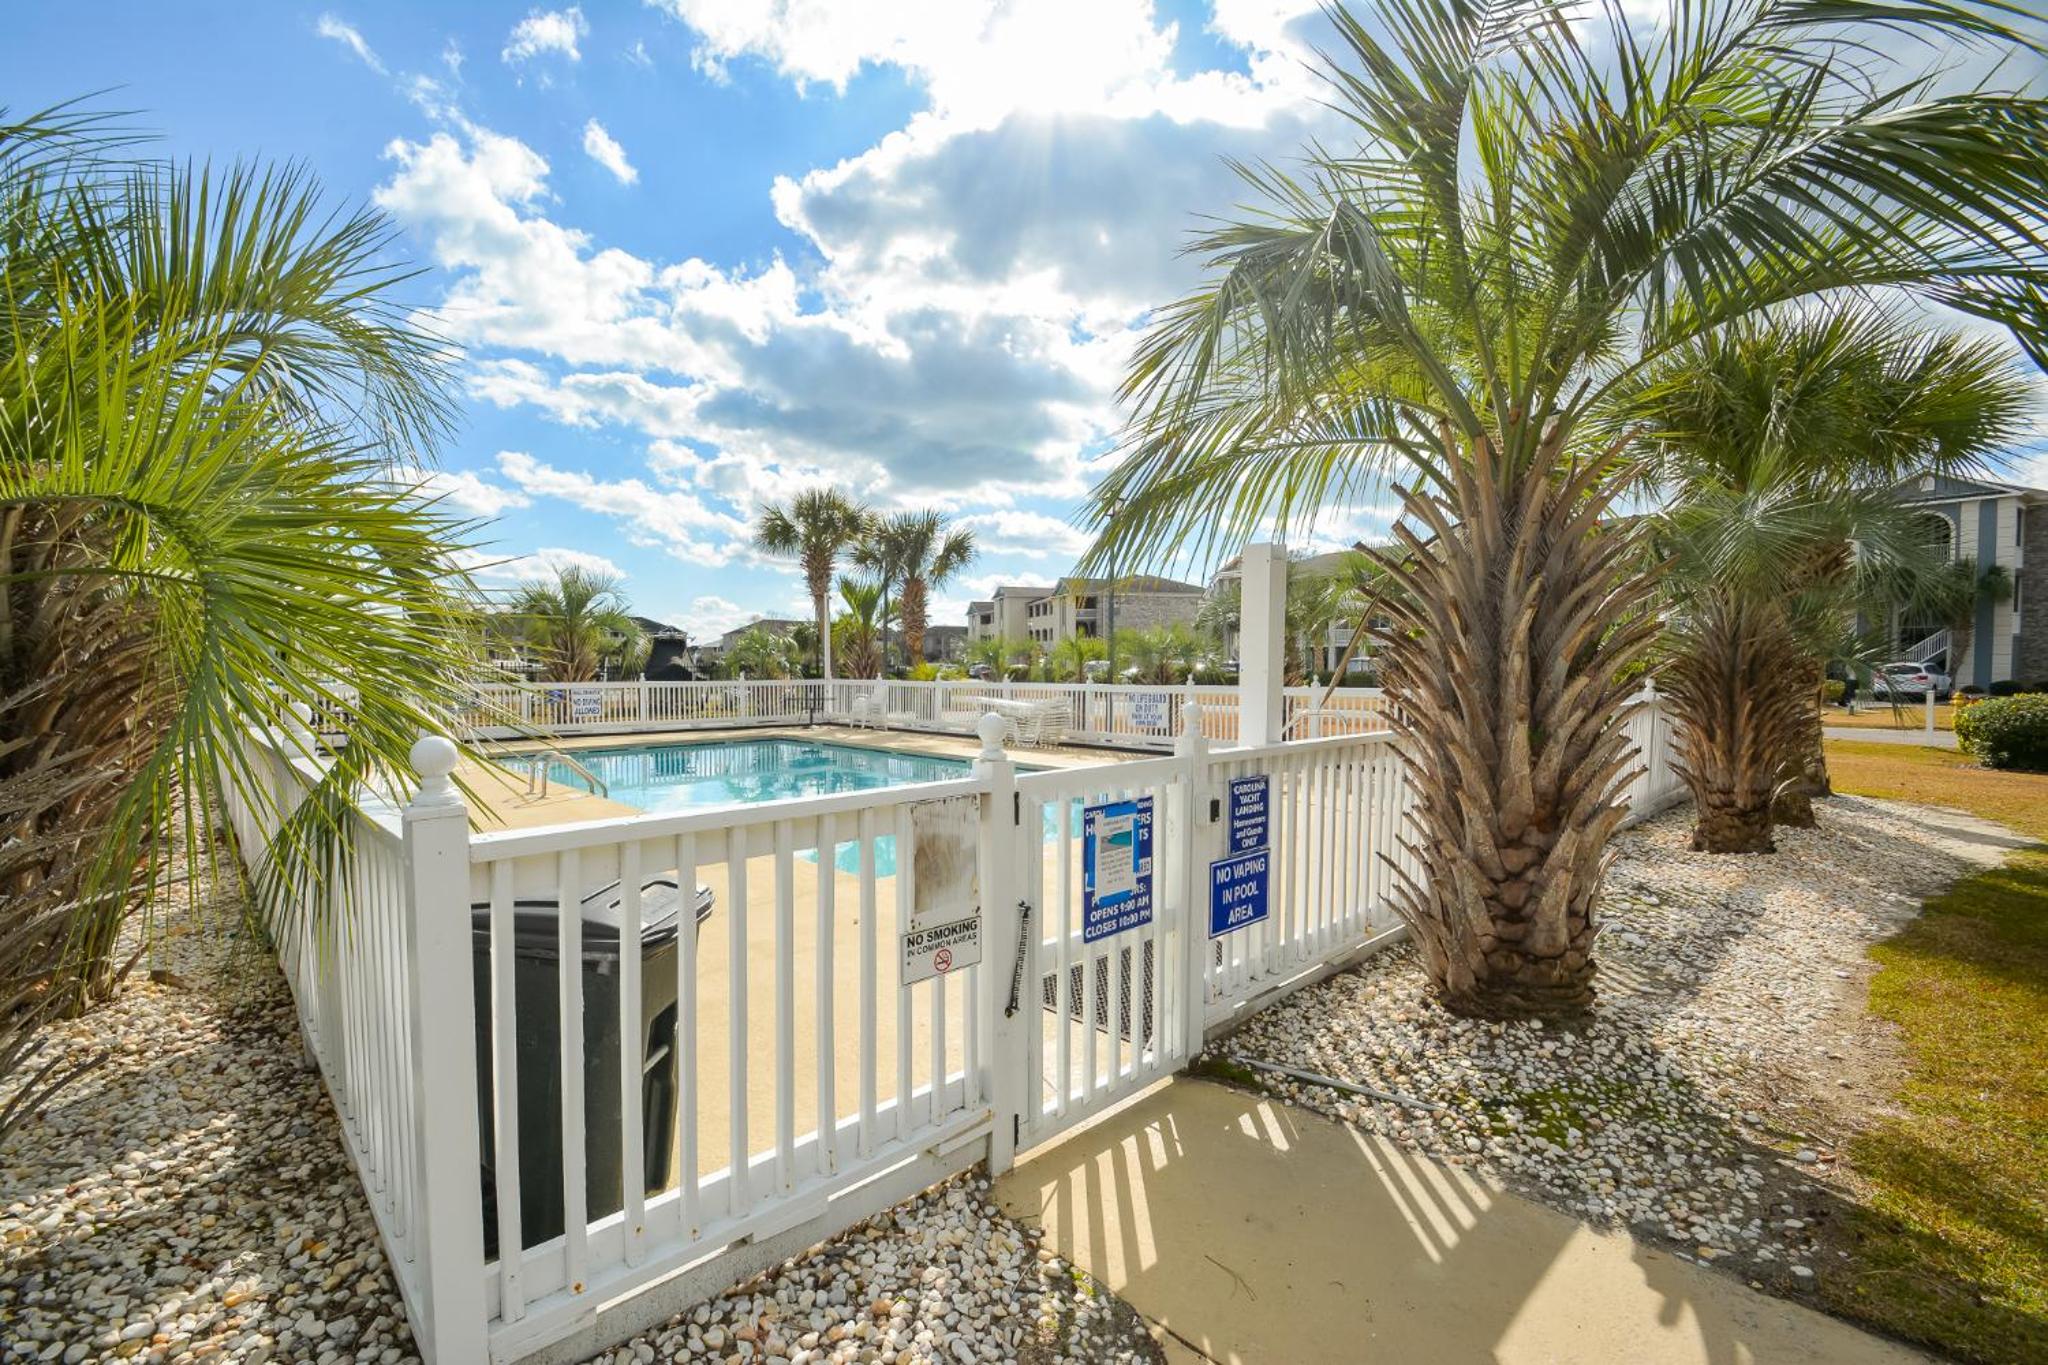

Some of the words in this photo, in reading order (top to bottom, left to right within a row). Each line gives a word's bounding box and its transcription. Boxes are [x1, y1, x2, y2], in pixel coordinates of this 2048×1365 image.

[1233, 781, 1266, 795] CAROLINA
[1239, 793, 1261, 804] YACHT
[1235, 802, 1264, 816] LANDING
[1241, 836, 1258, 848] ONLY
[1216, 867, 1231, 885] NO
[1233, 858, 1265, 879] VAPING
[1222, 888, 1233, 905] IN
[1234, 881, 1259, 902] POOL
[1090, 904, 1119, 922] OPENS
[1137, 895, 1149, 907] AM
[1228, 903, 1253, 925] AREA
[907, 934, 924, 948] NO
[926, 920, 977, 942] SMOKING
[1085, 919, 1117, 938] CLOSES
[1119, 912, 1138, 927] 10:00
[1140, 908, 1151, 920] PM
[907, 949, 915, 957] IN
[917, 939, 951, 955] COMMON
[952, 932, 977, 944] AREAS
